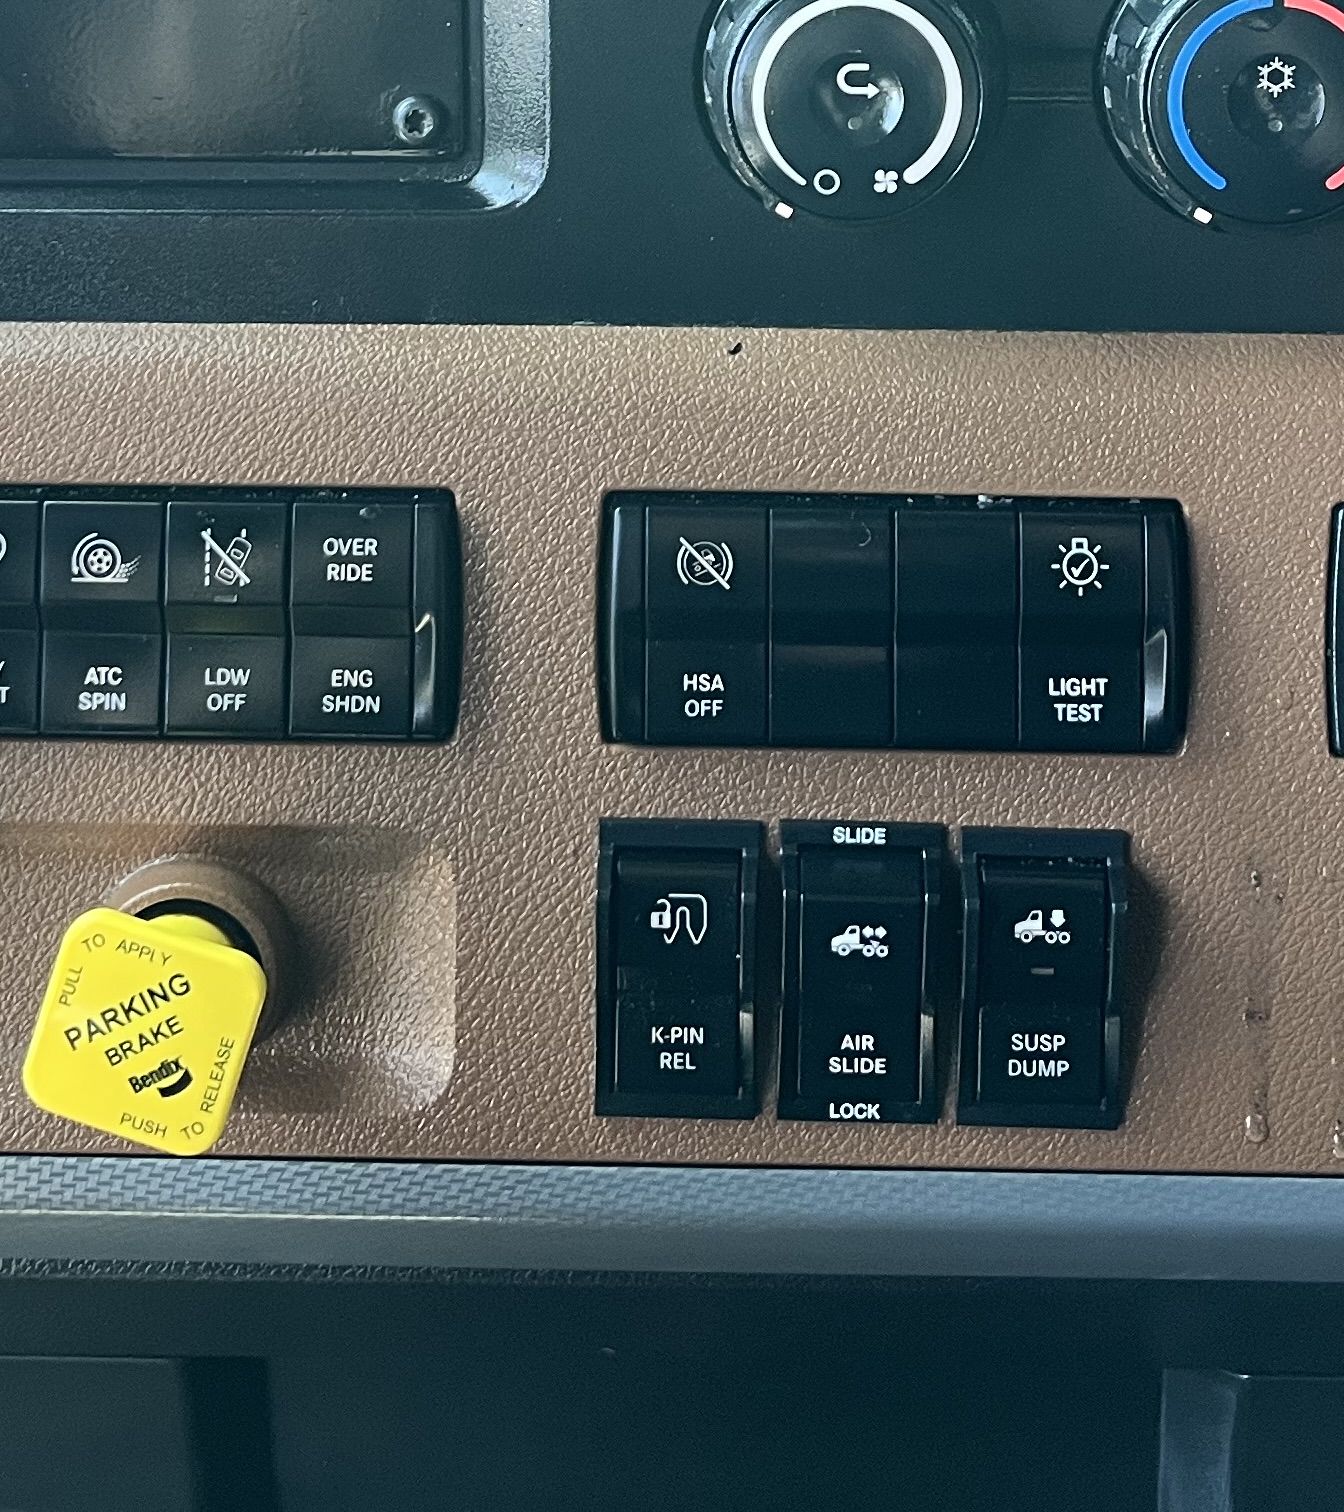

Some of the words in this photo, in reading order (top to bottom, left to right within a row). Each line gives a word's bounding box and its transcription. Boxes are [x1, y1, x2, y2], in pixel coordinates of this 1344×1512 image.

[323, 538, 377, 556] OVER
[327, 564, 373, 581] RIDE
[84, 667, 122, 685] ATC
[205, 668, 250, 685] LDW
[332, 669, 372, 687] ENG
[684, 674, 724, 691] HSA
[1049, 678, 1108, 696] LIGHT
[79, 692, 125, 710] SPIN
[207, 694, 246, 711] OFF
[323, 695, 380, 713] SHDN
[685, 699, 723, 717] OFF
[1054, 704, 1103, 722] TEST
[833, 827, 886, 844] SLIDE
[59, 965, 84, 1006] PULL
[81, 933, 106, 953] TO
[64, 973, 191, 1050] PARKING
[105, 1015, 184, 1067] BRAKE
[652, 1027, 703, 1044] K-PIN
[841, 1035, 874, 1050] AIR
[1012, 1034, 1065, 1051] SUSP
[660, 1052, 696, 1069] REL
[829, 1057, 886, 1074] SLIDE
[1009, 1059, 1069, 1076] DUMP
[128, 1055, 183, 1093] Bendix
[120, 1113, 168, 1138] PUSH
[180, 1121, 204, 1140] TO
[200, 1037, 235, 1113] RELEASE
[830, 1103, 880, 1119] LOCK
